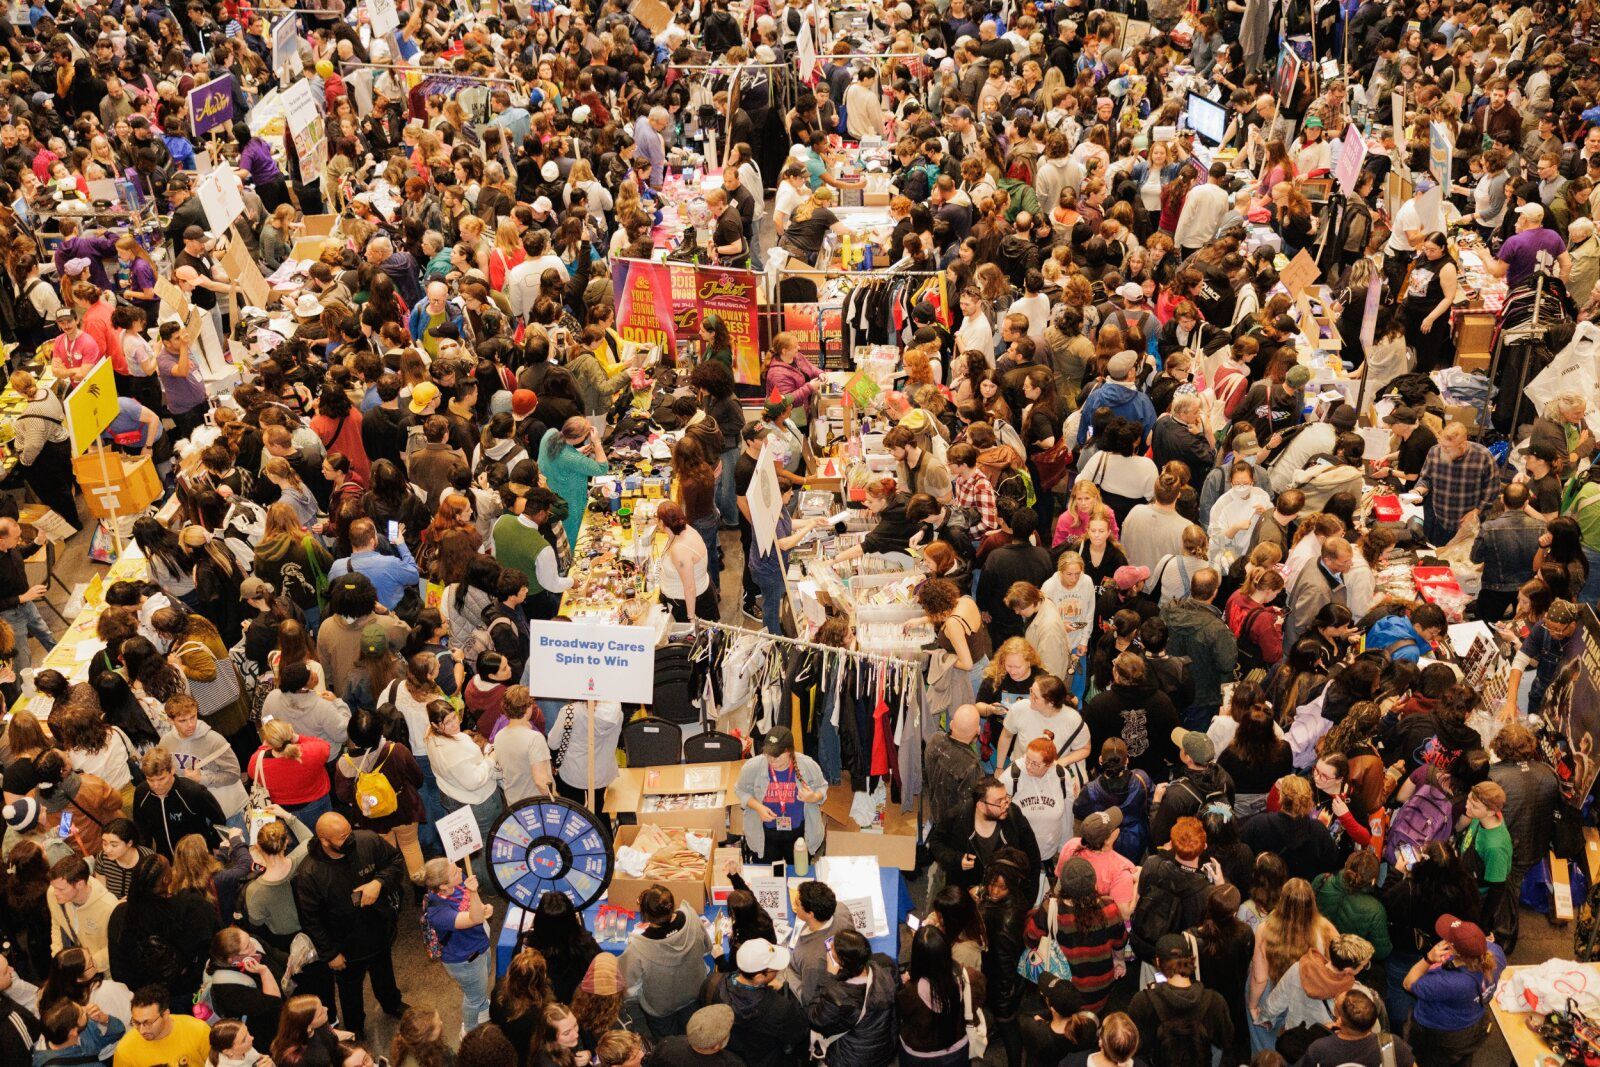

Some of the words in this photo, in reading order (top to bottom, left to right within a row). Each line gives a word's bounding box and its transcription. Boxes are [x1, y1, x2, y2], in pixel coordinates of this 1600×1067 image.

[631, 290, 653, 302] YOU'RE
[699, 281, 754, 300] Juliet
[1200, 281, 1221, 301] OURCE
[632, 302, 654, 315] GONNA
[717, 301, 748, 310] MUSICAL
[629, 314, 646, 327] HEAR
[647, 317, 660, 329] HER
[703, 308, 750, 323] BROADWAY'S
[540, 636, 604, 652] Broadway
[608, 640, 645, 652] Cares
[555, 653, 584, 666] Spin
[587, 654, 600, 665] to
[604, 656, 628, 667] Win
[169, 812, 182, 821] NY
[1180, 865, 1197, 873] SONY
